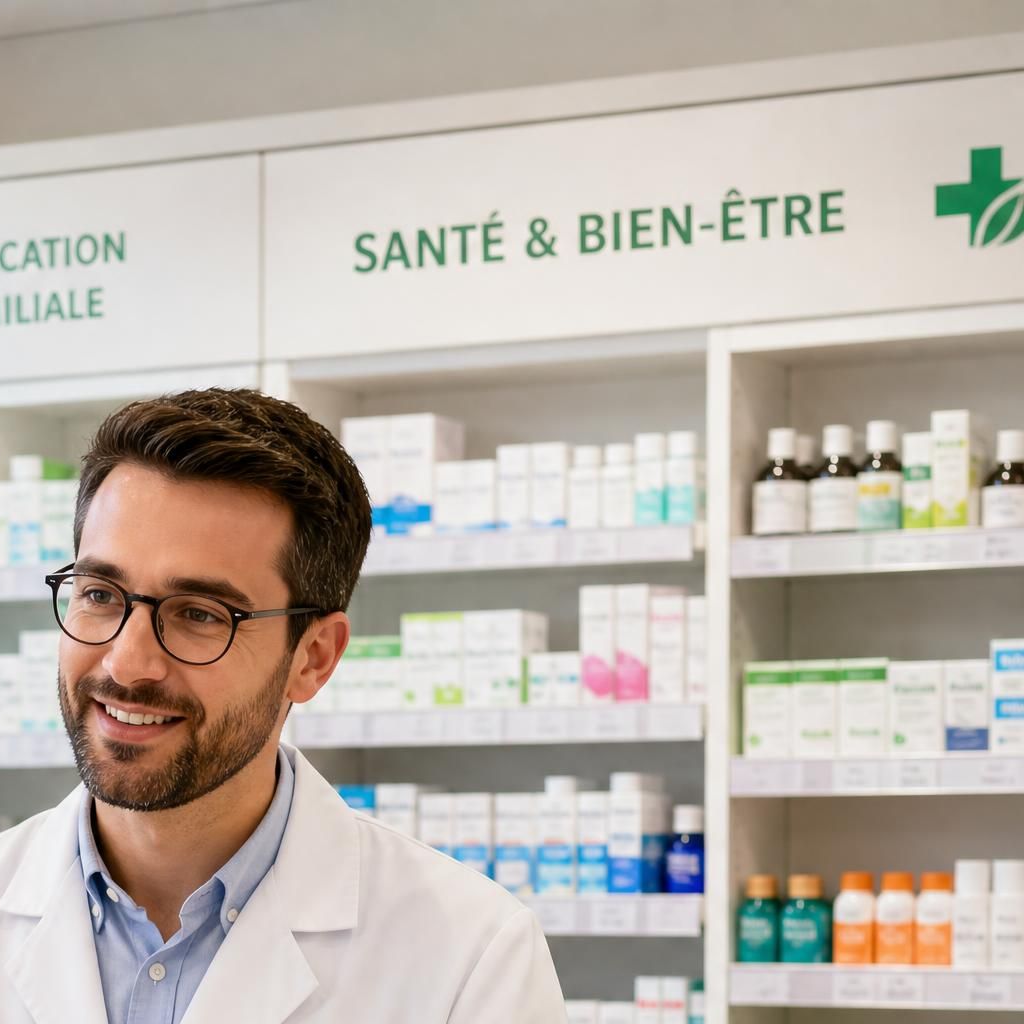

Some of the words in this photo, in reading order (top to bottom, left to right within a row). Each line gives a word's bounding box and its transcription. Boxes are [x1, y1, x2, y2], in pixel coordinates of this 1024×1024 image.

[354, 211, 504, 274] SANTÉ
[525, 217, 557, 259] &
[579, 188, 846, 254] BIEN-ÊTRE
